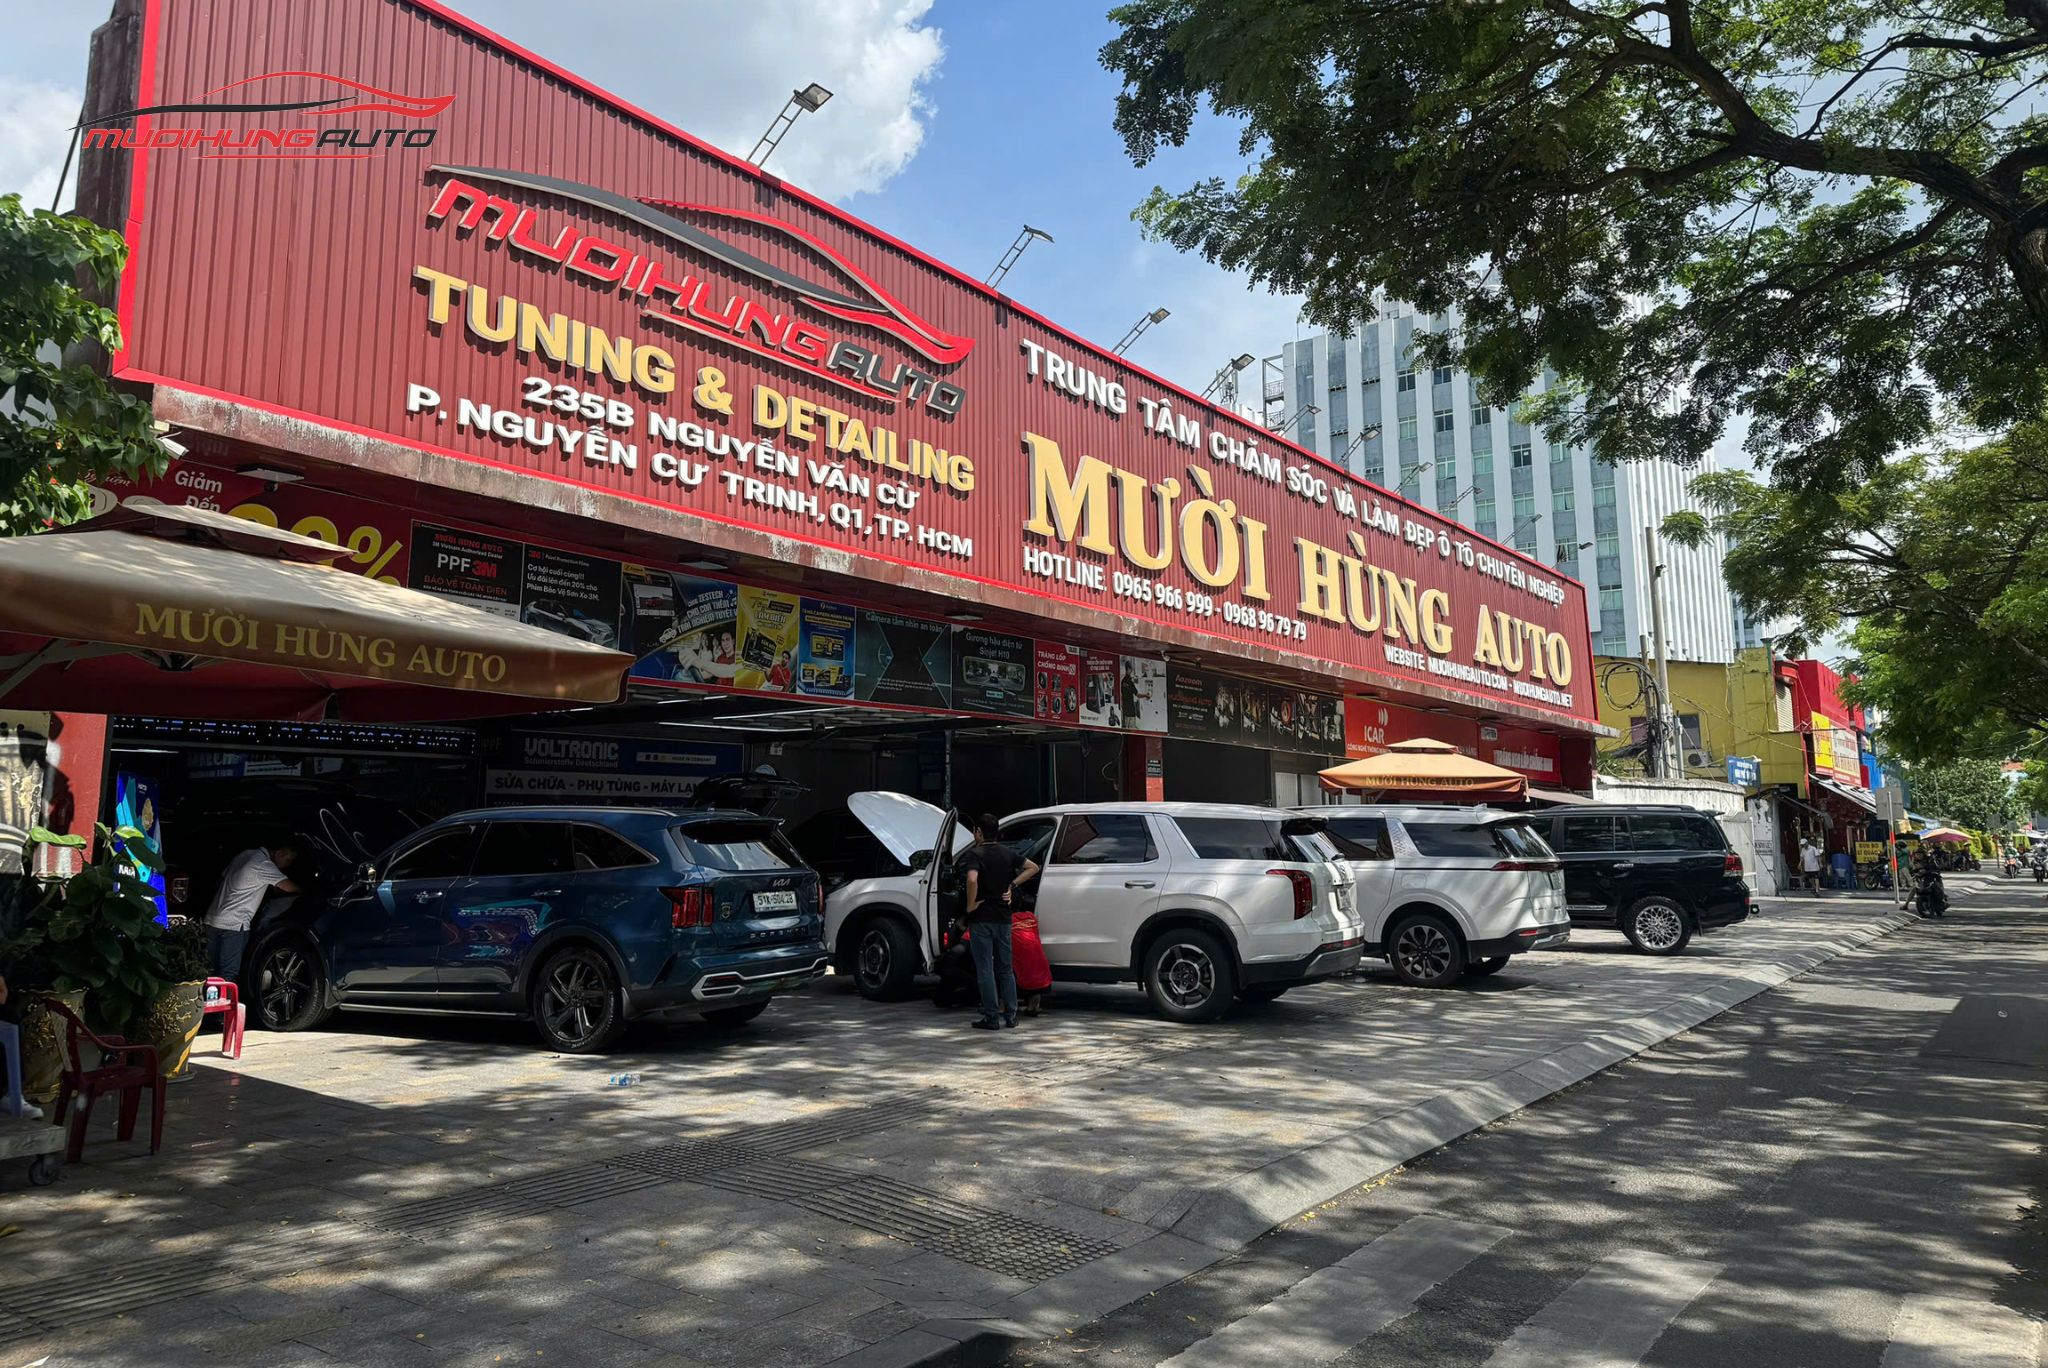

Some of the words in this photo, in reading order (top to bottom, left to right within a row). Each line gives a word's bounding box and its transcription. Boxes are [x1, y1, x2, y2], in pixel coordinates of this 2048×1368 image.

[412, 264, 676, 394] TUNING
[692, 365, 735, 416] &
[752, 384, 976, 491] DETAILING
[521, 376, 635, 428] 235B
[648, 410, 800, 477] NGUYỄN
[806, 458, 870, 498] VĂN
[875, 480, 921, 510] CỪ
[174, 470, 223, 494] Giảm
[405, 382, 448, 420] P.
[456, 398, 638, 471] NGUYỄN
[651, 451, 710, 486] CƯ
[719, 470, 827, 523] TRINH,
[916, 524, 974, 558] HCM
[1021, 338, 1128, 415] TRUNG
[1138, 396, 1201, 450] TÂM
[1208, 431, 1281, 484] CHĂM
[1285, 464, 1328, 504] SÓC
[1331, 484, 1358, 519] VÀ
[1360, 498, 1400, 536] LÀM
[1403, 519, 1435, 552] ĐẸP
[1437, 530, 1451, 557] Ô
[1453, 541, 1475, 567] TÔ
[1476, 552, 1527, 589] CHUYÊN
[1528, 574, 1566, 609] NGHIỆP
[184, 494, 221, 513] Đến
[437, 552, 471, 573] PPF
[471, 559, 497, 578] 3M
[1021, 431, 1272, 602] MƯỜI
[1292, 530, 1454, 654] HÙNG
[1473, 603, 1573, 688] AUTO
[572, 580, 586, 589] 20%
[1112, 570, 1152, 602] 0965
[1154, 582, 1183, 611] 966
[1185, 591, 1213, 617] 999
[1222, 601, 1257, 629] 0968
[1257, 610, 1274, 633] 96
[1274, 614, 1291, 637] 79
[1290, 620, 1307, 641] 79
[135, 603, 260, 651] MƯỜI
[274, 620, 397, 668] HÙNG
[406, 643, 507, 682] AUTO
[1364, 726, 1385, 744] ICAR
[523, 737, 620, 760] VOLTRONIC
[495, 771, 524, 790] SỬA
[527, 775, 566, 790] CHỮA
[577, 779, 604, 794] PHỤ
[607, 777, 641, 793] TÙNG
[651, 779, 674, 793] MÁY
[1439, 778, 1475, 787] AUTO
